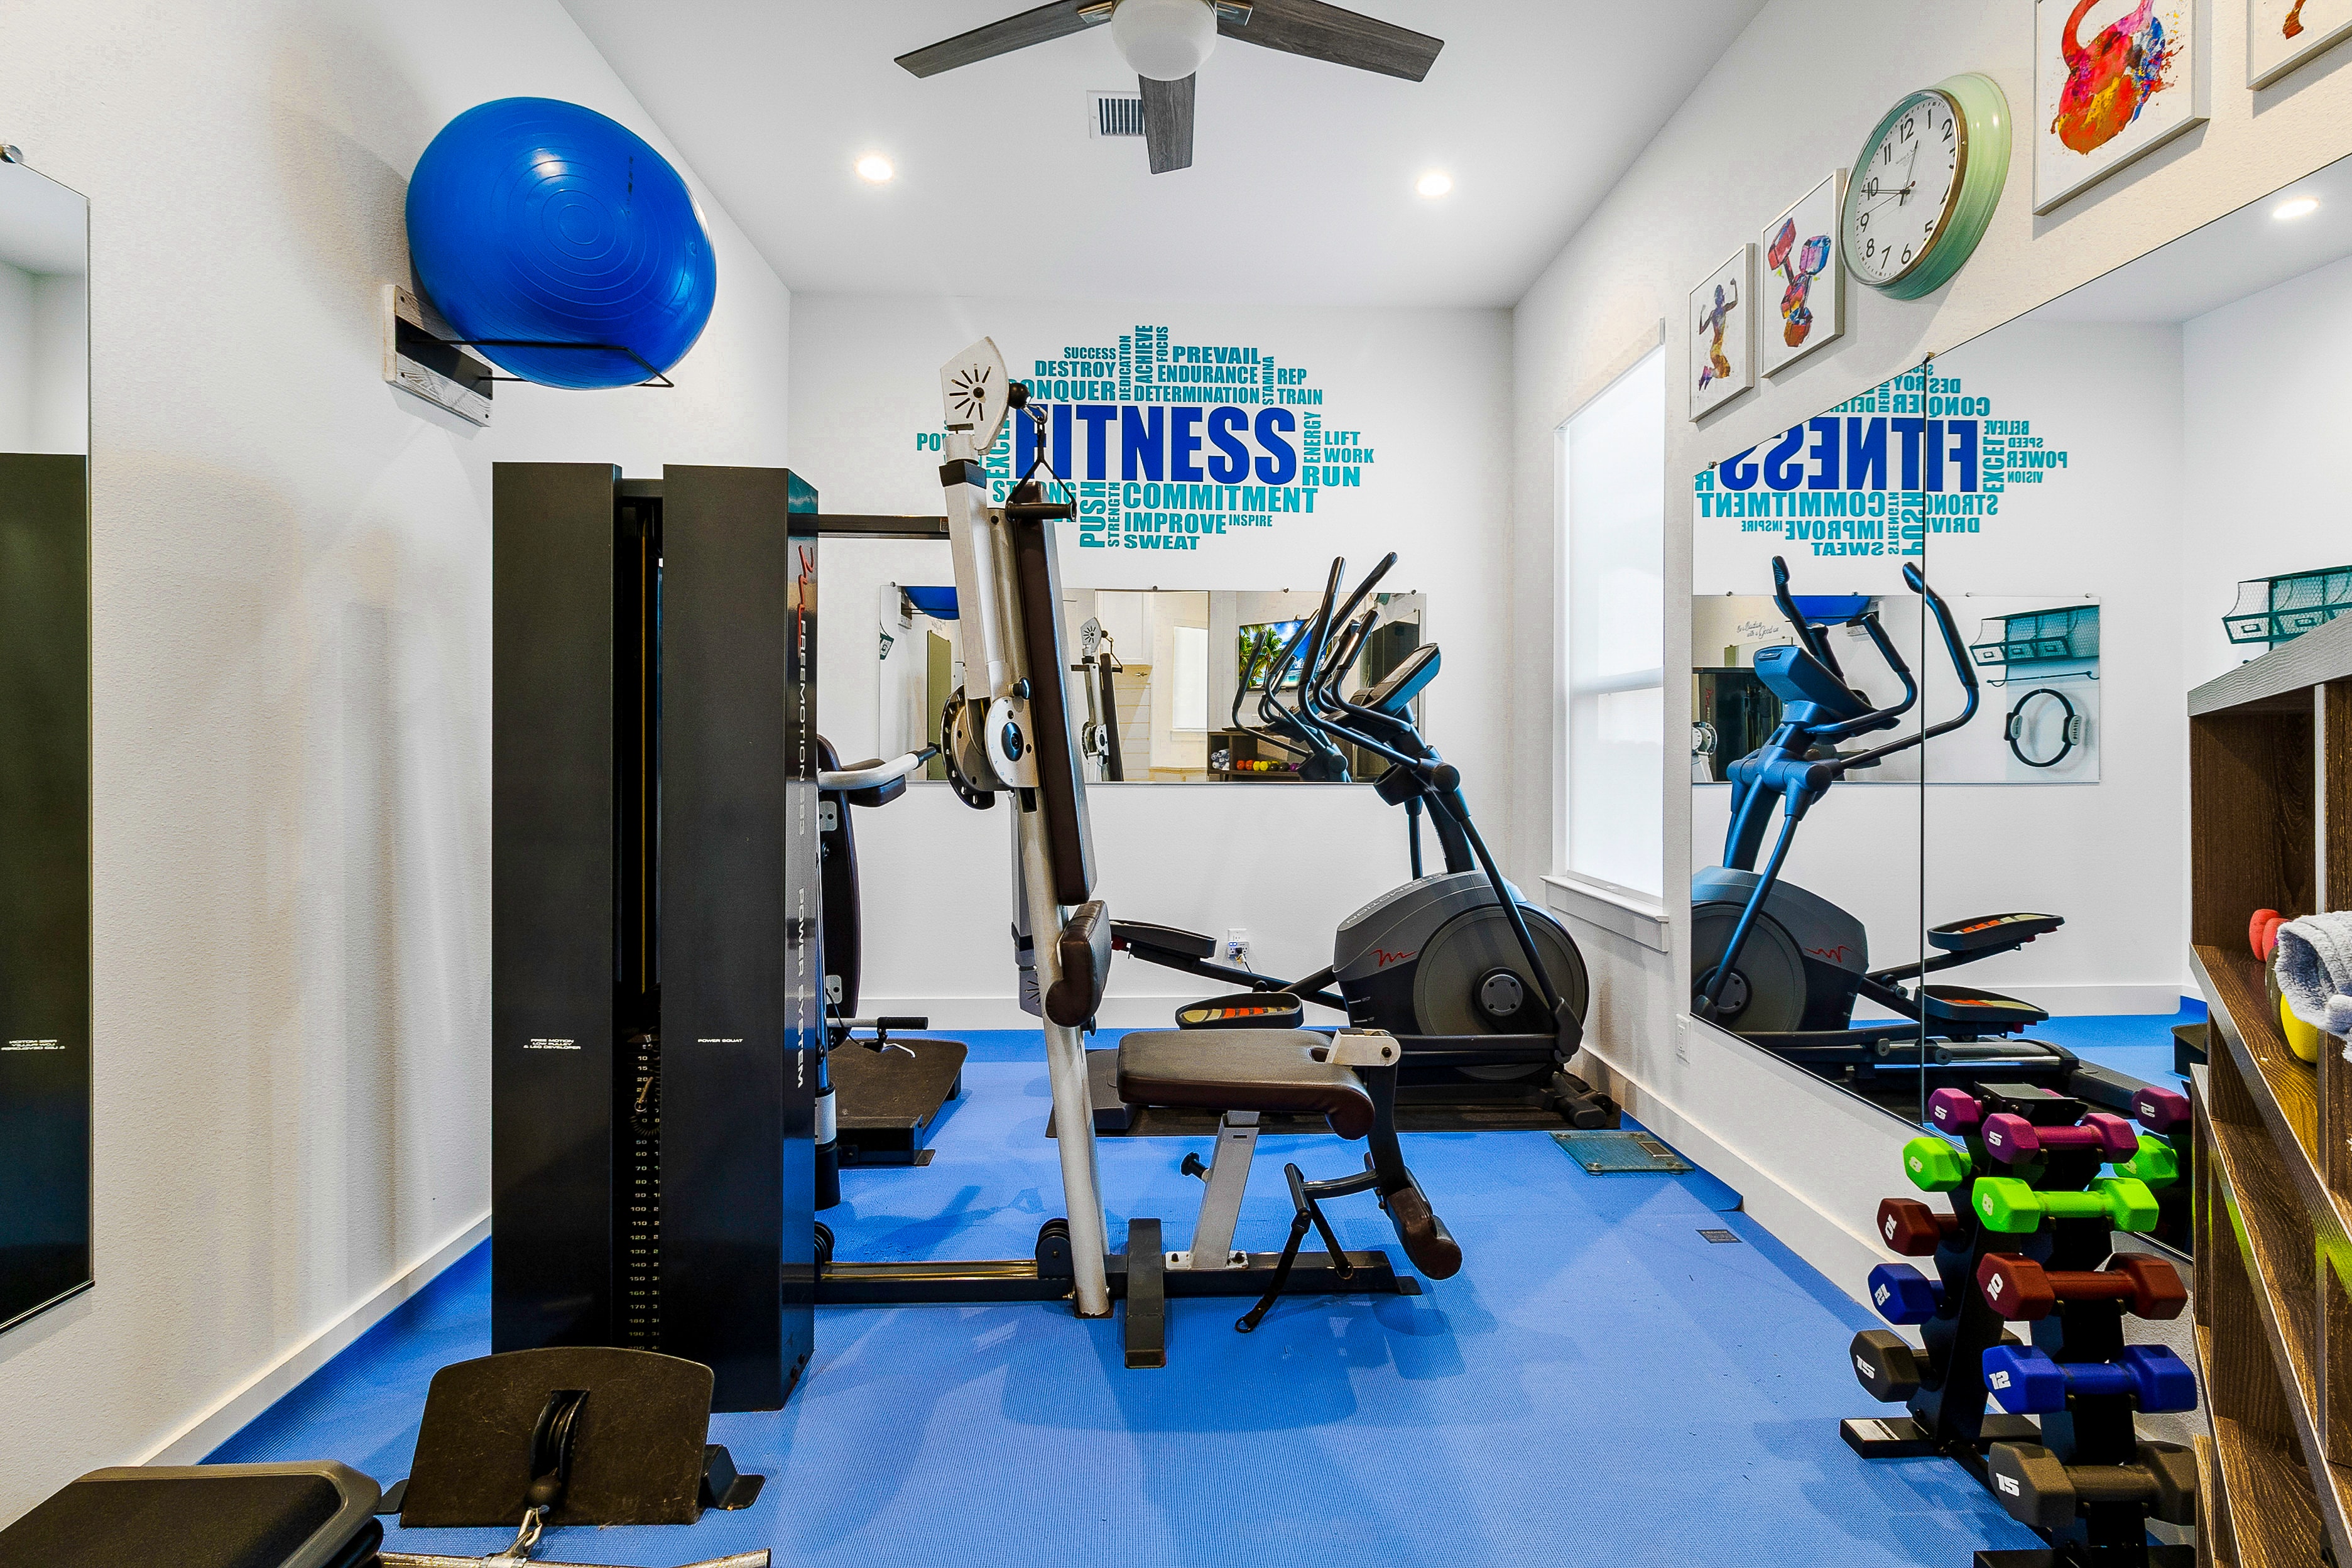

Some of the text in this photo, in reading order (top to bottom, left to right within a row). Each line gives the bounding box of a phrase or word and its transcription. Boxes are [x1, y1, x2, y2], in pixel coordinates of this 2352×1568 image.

[1927, 109, 1932, 129] 1
[1900, 118, 1914, 143] 12
[1941, 118, 1952, 143] 2
[1884, 143, 1892, 165] 11
[1866, 177, 1878, 201] 10
[1860, 212, 1869, 232] 9
[1866, 238, 1875, 258] 8
[1881, 245, 1892, 269] 7
[1901, 243, 1912, 264] 6
[1064, 346, 1116, 360] SUCCESS
[1135, 325, 1153, 384] ACHIEVE
[1156, 326, 1168, 362] FOCUS
[1172, 346, 1261, 365] PREVAIL
[1035, 360, 1116, 378] DESTROY
[1119, 335, 1131, 401] DEDICATION
[1157, 364, 1258, 384] ENDURANCE
[1277, 368, 1307, 385] REP
[1008, 379, 1116, 402] ONQUER
[1262, 356, 1274, 405] STAMINA
[1134, 385, 1260, 404] DETERMINATION
[1277, 388, 1323, 405] TRAIN
[1015, 403, 1296, 485] FITNESS
[1304, 411, 1321, 463] ENERGY
[1324, 431, 1361, 445] LIFT
[1324, 448, 1375, 464] WORK
[1302, 466, 1360, 487] RUN
[1123, 482, 1318, 513] COMMITMENT
[1079, 482, 1106, 548] PUSH
[1108, 482, 1120, 547] STRENGTH
[1124, 512, 1227, 534] IMPROVE
[1229, 514, 1273, 527] INSPIRE
[1124, 535, 1200, 550] SWEAT
[1935, 1106, 1947, 1120] 5
[1989, 1131, 2003, 1146] 5
[1909, 1156, 1923, 1173] 8
[1982, 1194, 1994, 1216] 8
[1987, 1273, 2003, 1301] 10
[1856, 1354, 1875, 1379] 15
[1989, 1371, 2011, 1390] 12
[1996, 1473, 2020, 1497] 15
